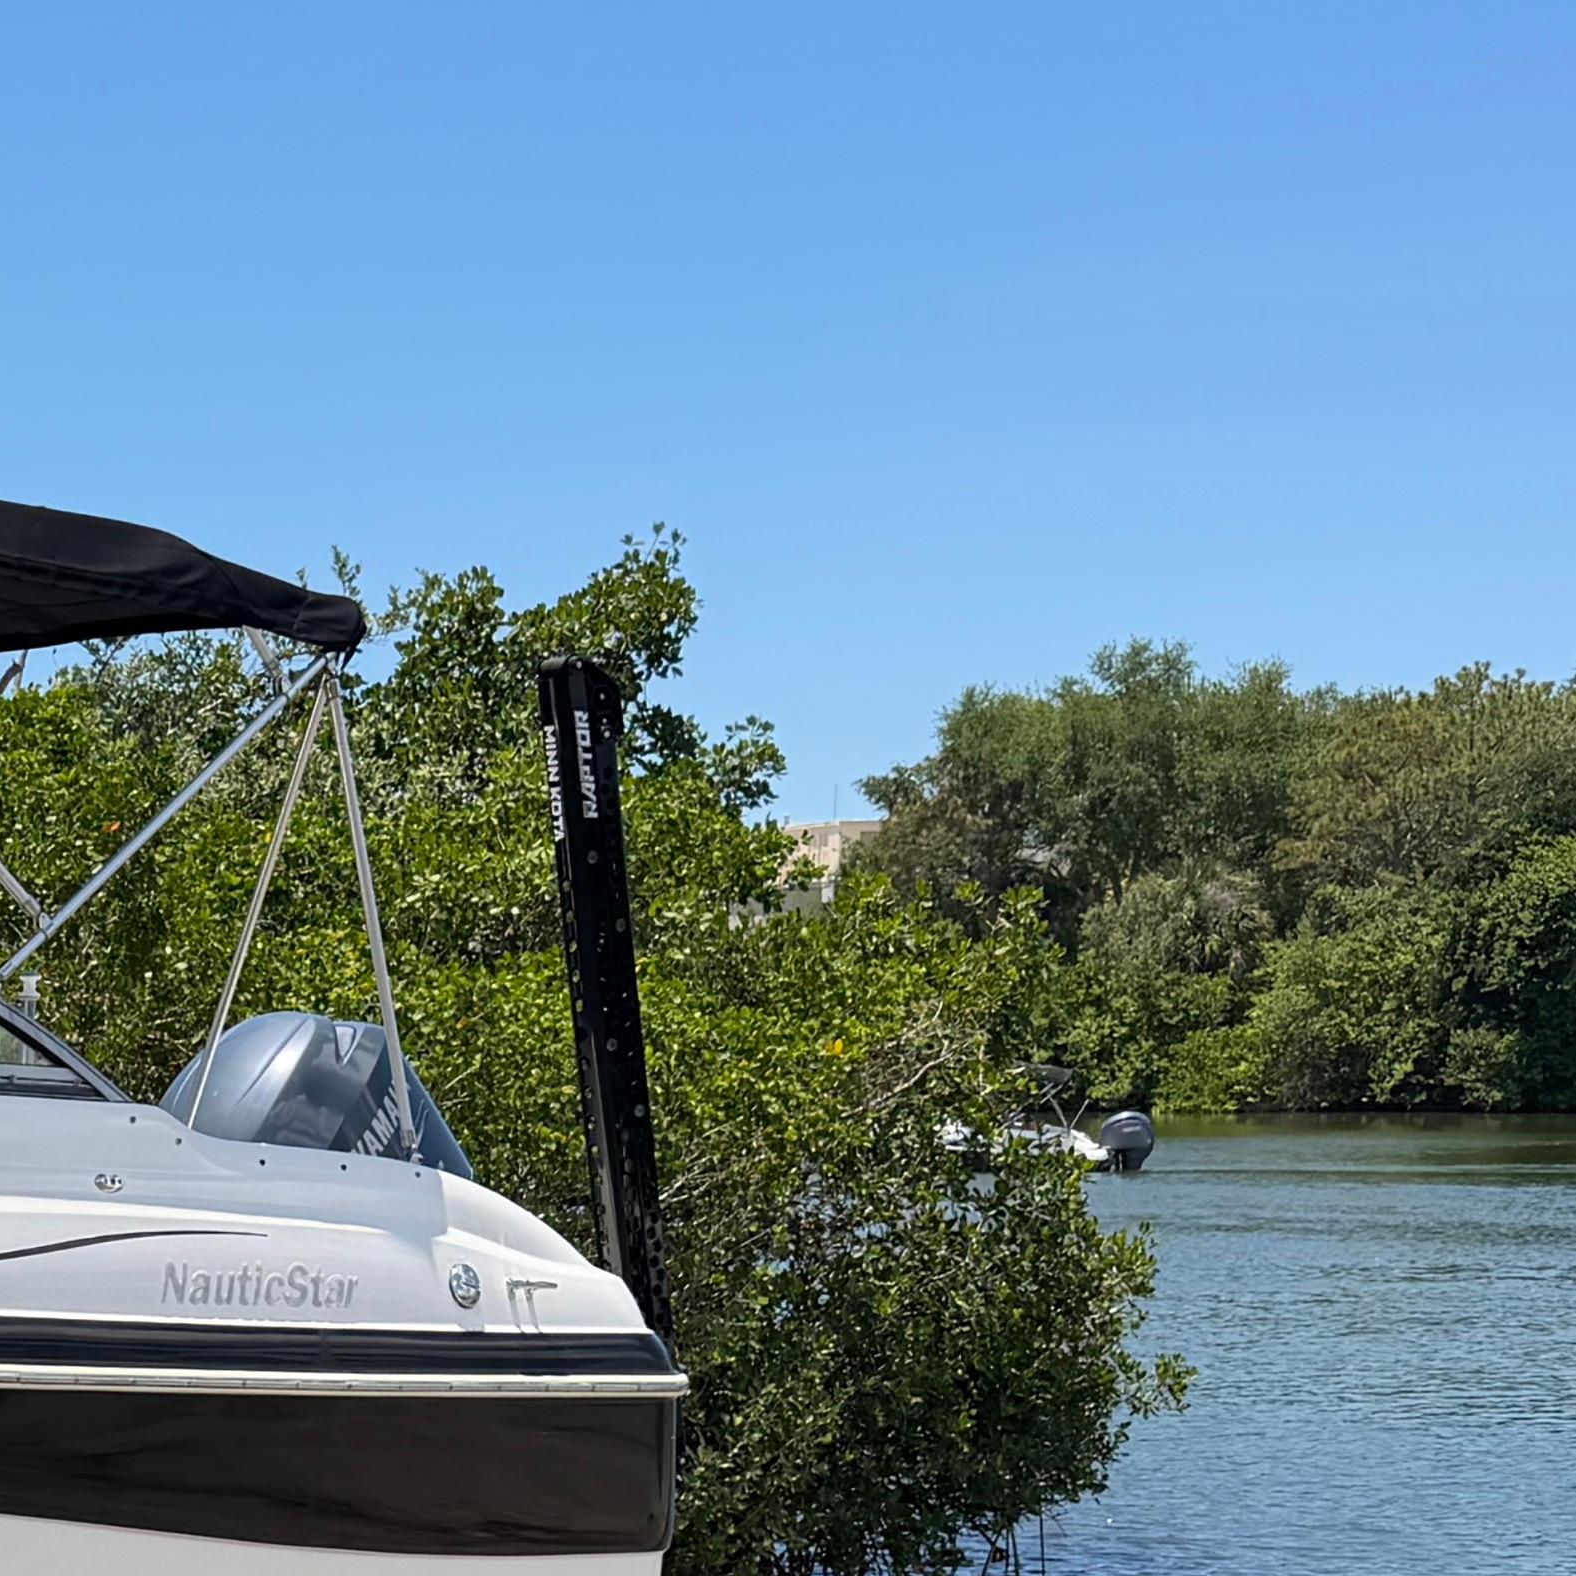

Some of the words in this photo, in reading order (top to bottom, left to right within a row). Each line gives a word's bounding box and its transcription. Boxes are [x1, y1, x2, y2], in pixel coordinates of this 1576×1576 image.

[544, 725, 560, 782] MINN
[574, 710, 599, 819] RAPTOR
[550, 786, 565, 842] KOTA
[160, 1258, 360, 1309] NauticStar
